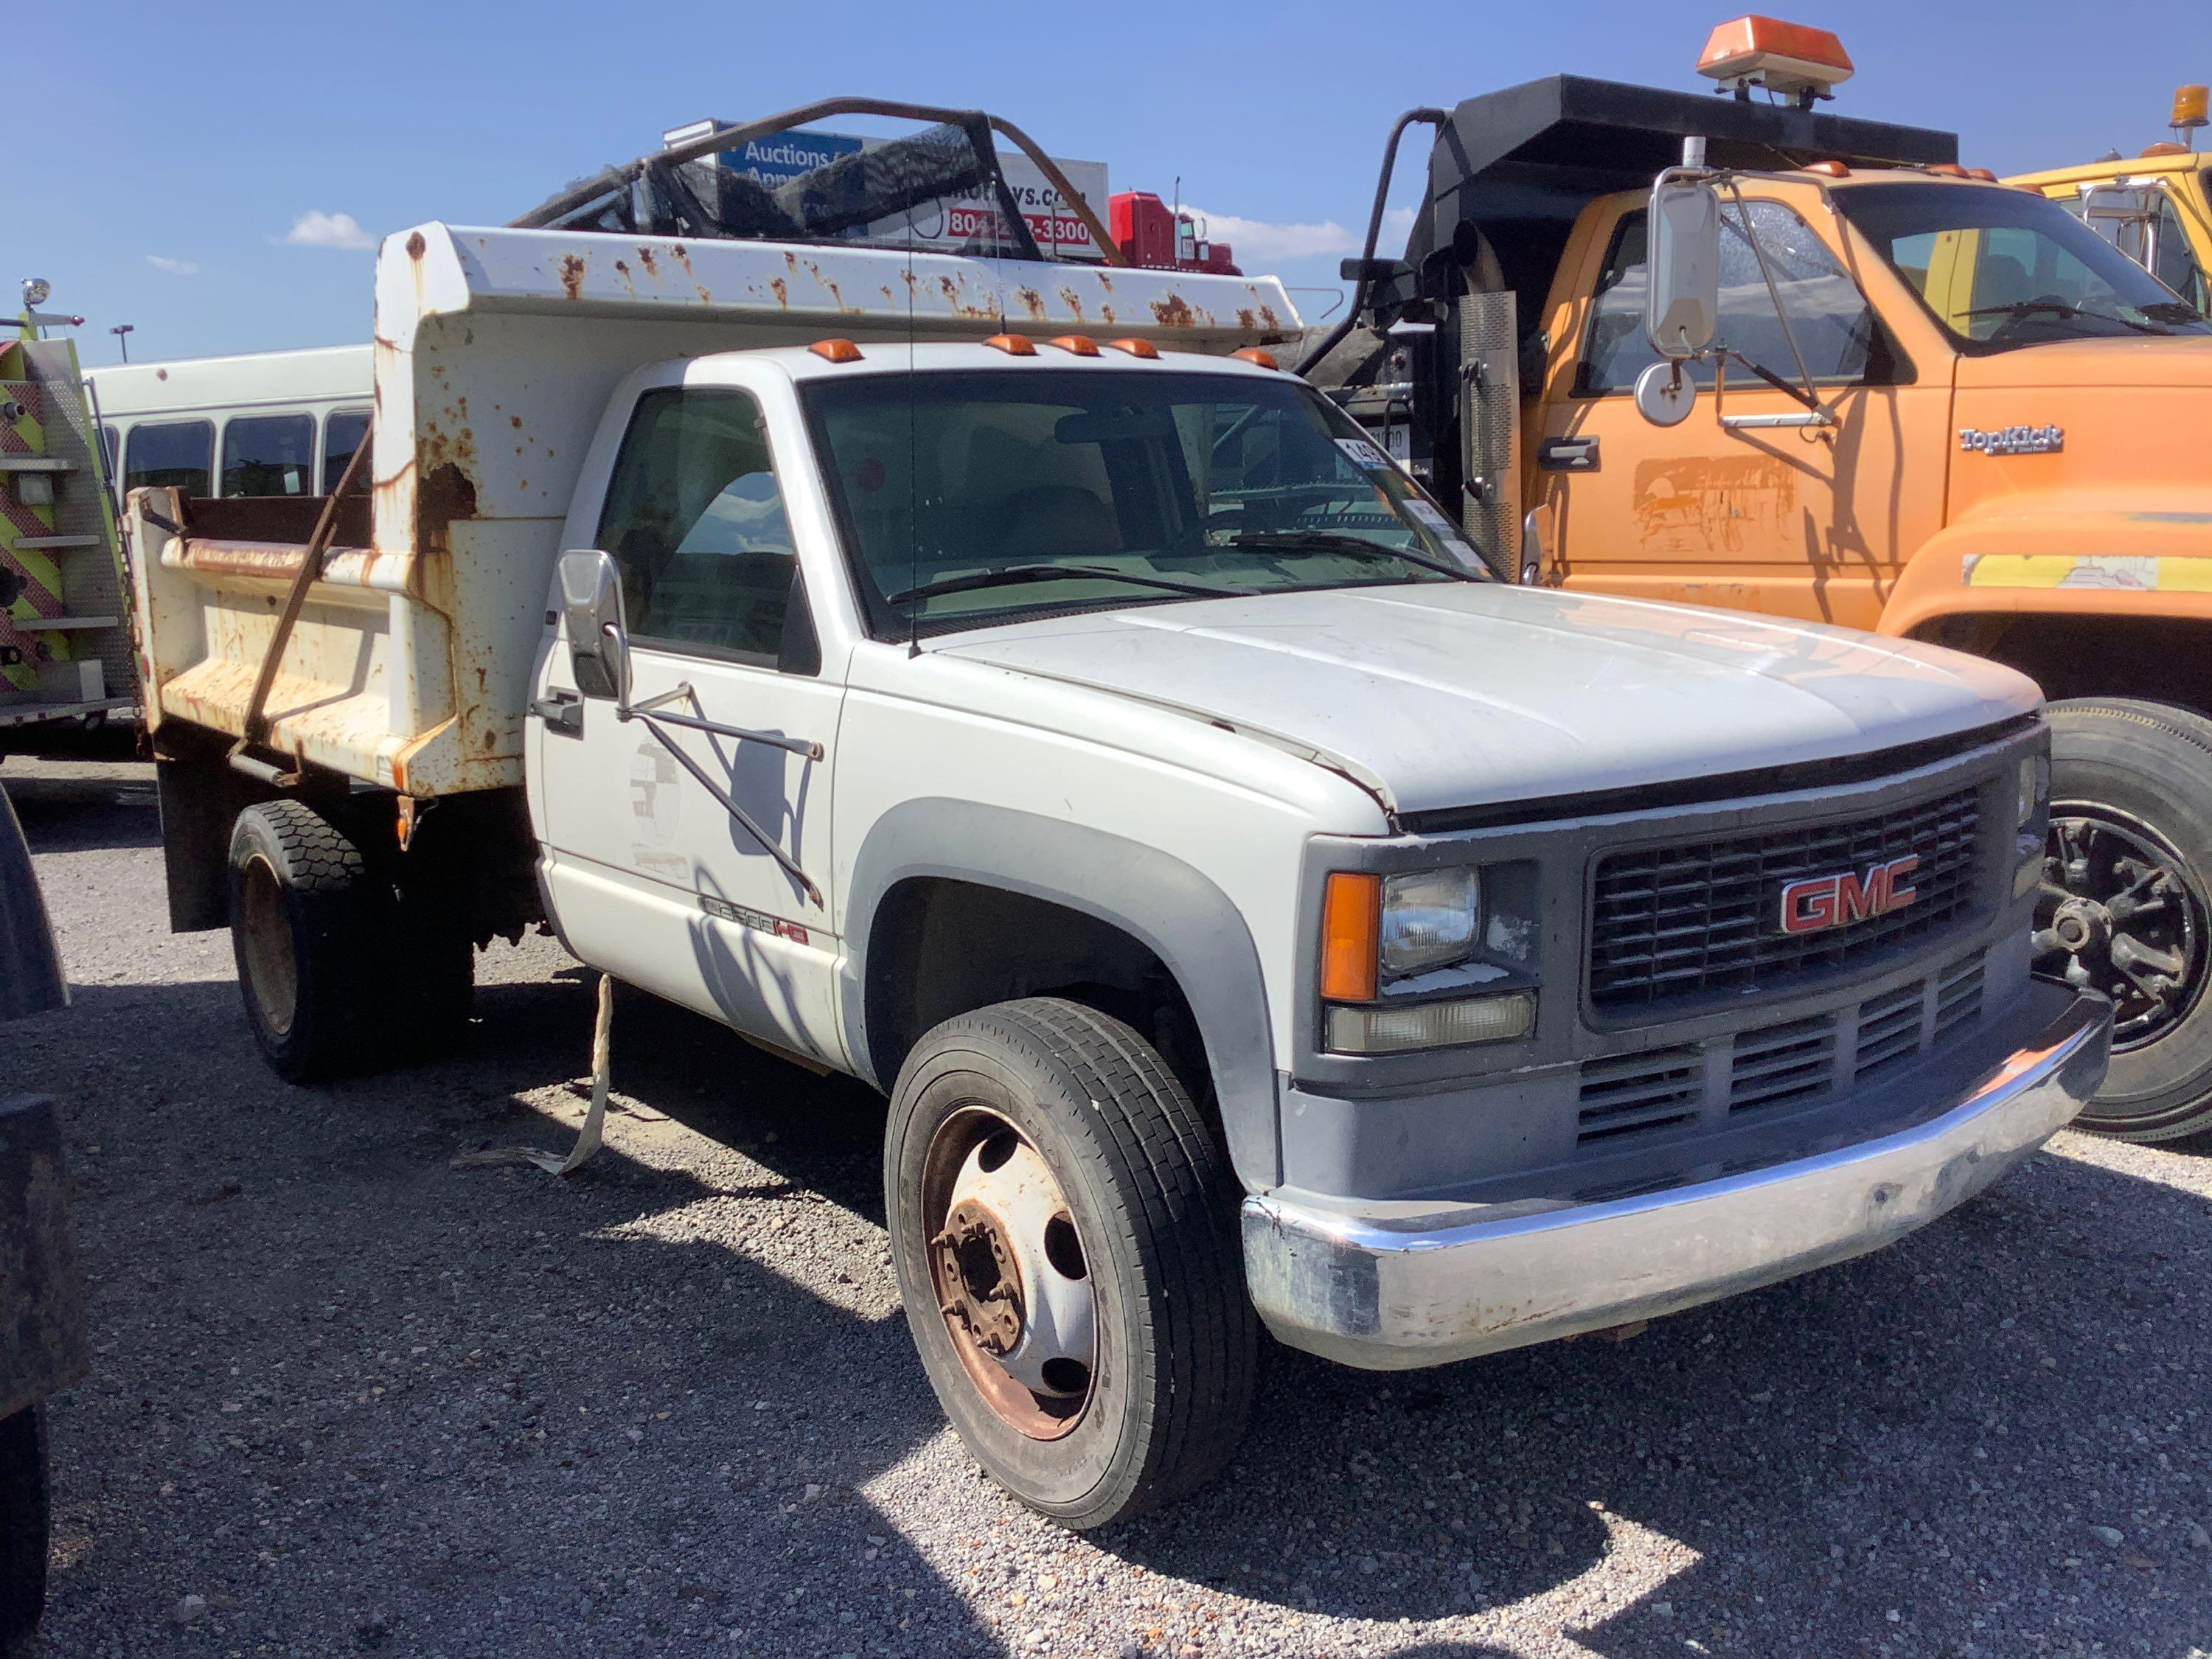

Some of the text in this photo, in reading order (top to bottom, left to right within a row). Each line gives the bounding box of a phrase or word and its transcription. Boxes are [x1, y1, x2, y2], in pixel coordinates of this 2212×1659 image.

[745, 141, 830, 167] Auctions
[1959, 425, 2064, 454] TopKick
[1781, 853, 1919, 933] GMC
